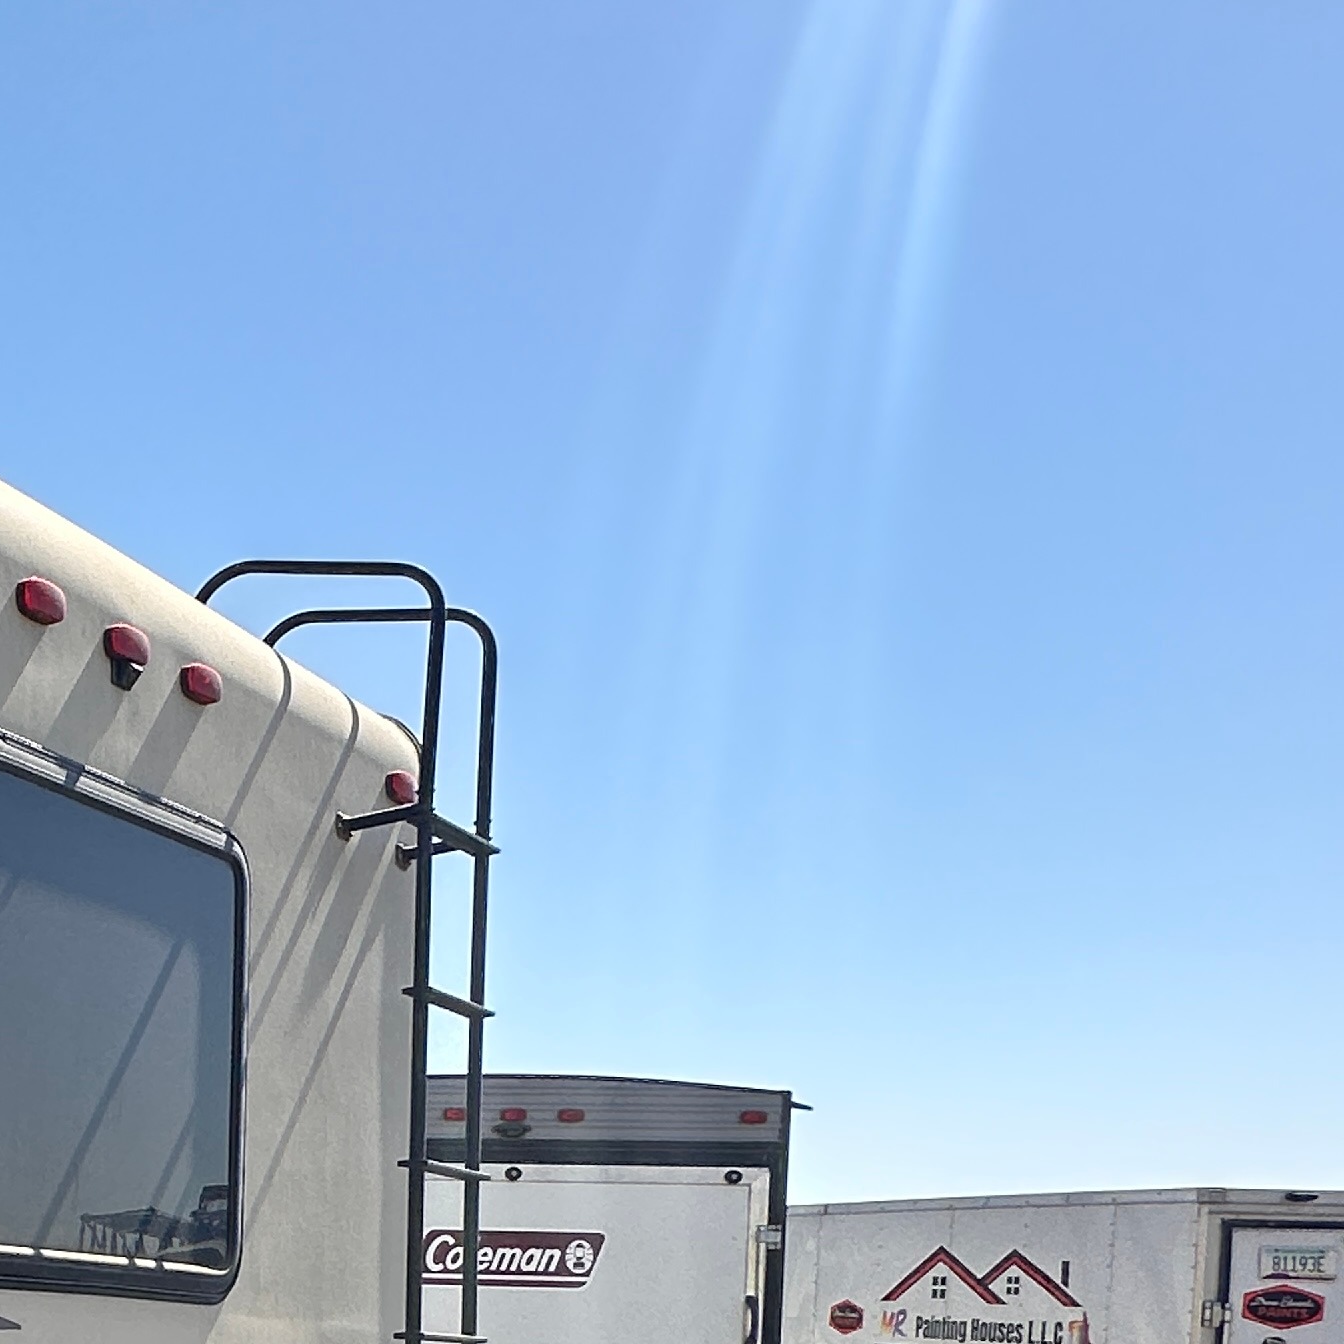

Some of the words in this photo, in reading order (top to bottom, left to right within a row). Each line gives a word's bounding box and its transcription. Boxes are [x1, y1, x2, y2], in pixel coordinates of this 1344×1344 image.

[425, 1234, 562, 1272] Coeman
[915, 1316, 967, 1343] Painting
[971, 1318, 1024, 1344] Houses
